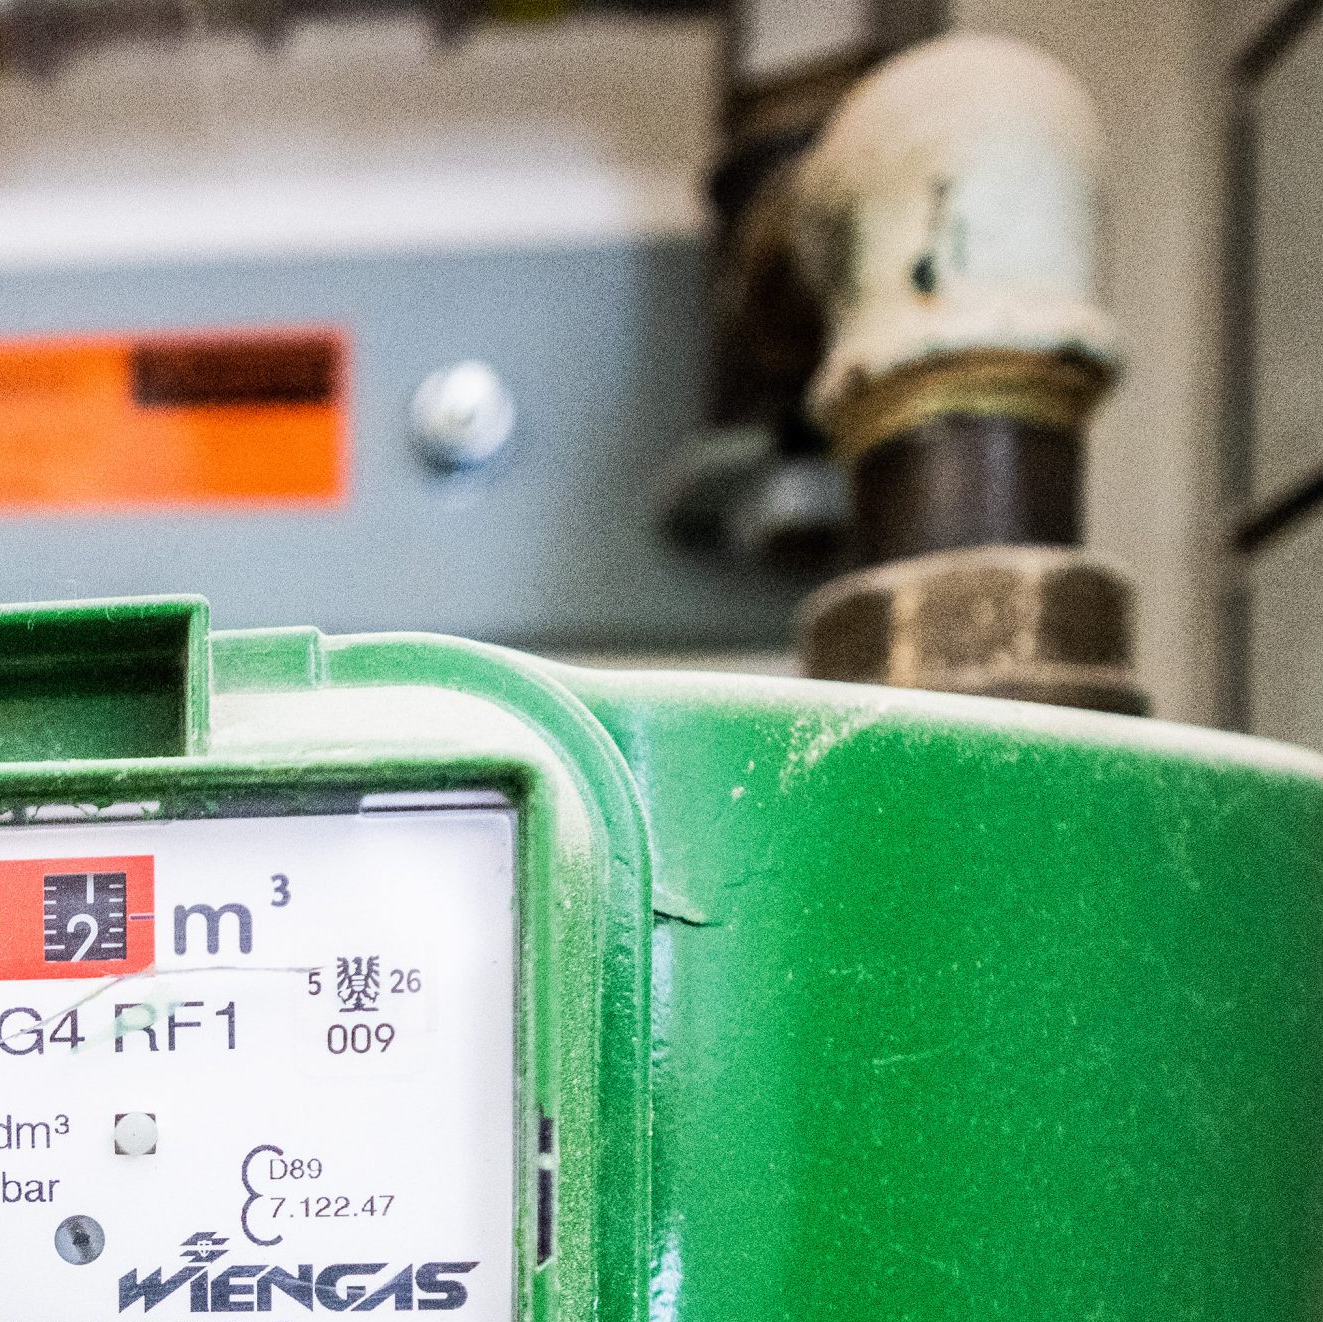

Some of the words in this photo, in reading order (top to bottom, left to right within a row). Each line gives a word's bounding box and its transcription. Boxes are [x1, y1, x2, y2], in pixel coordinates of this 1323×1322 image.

[389, 968, 422, 994] 26
[113, 1000, 238, 1053] RF1
[327, 1023, 396, 1055] 009
[269, 1158, 323, 1181] D89
[2, 1171, 61, 1203] bar
[271, 1195, 396, 1219] 7.122.47
